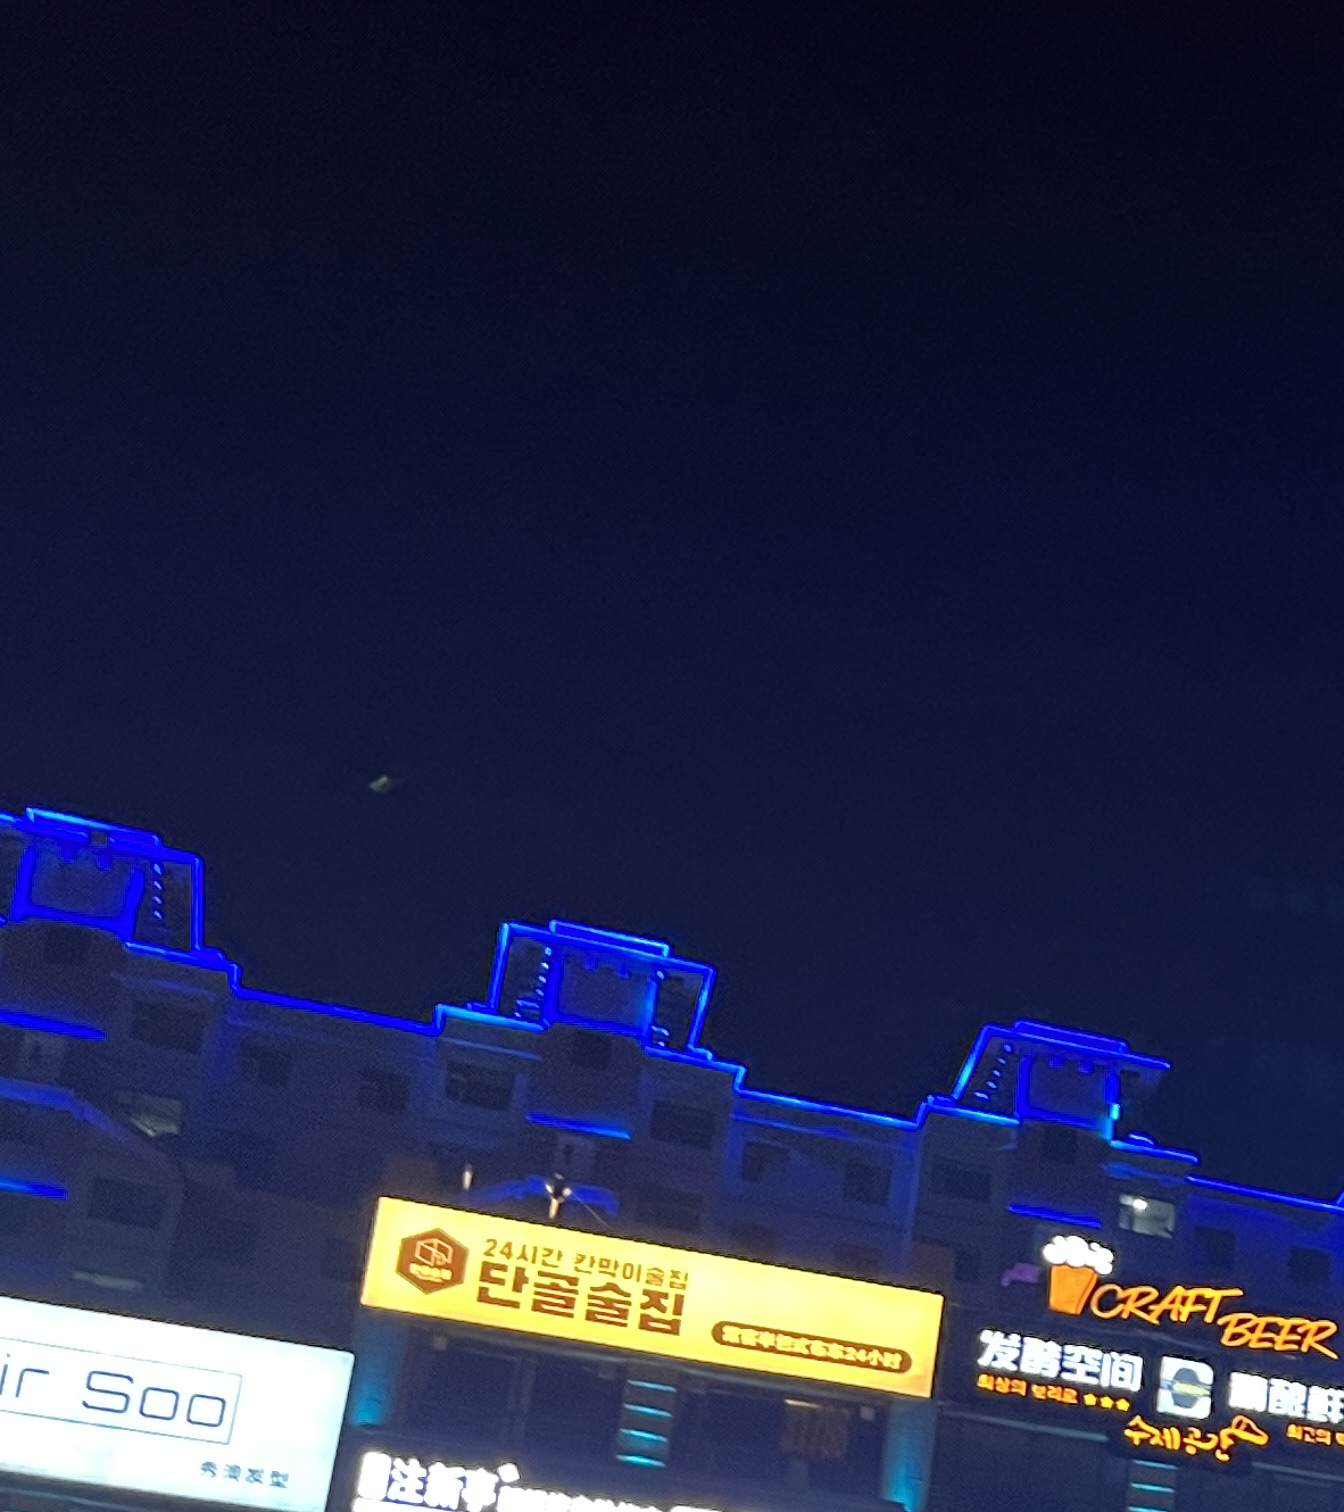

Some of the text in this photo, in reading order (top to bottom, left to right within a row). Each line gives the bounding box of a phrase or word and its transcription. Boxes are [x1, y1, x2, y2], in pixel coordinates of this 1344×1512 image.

[484, 1238, 562, 1268] 24시간
[476, 1261, 687, 1336] 단골술집
[1089, 1283, 1244, 1325] CRAFT
[1217, 1313, 1340, 1360] BEER
[81, 1369, 227, 1429] Soo
